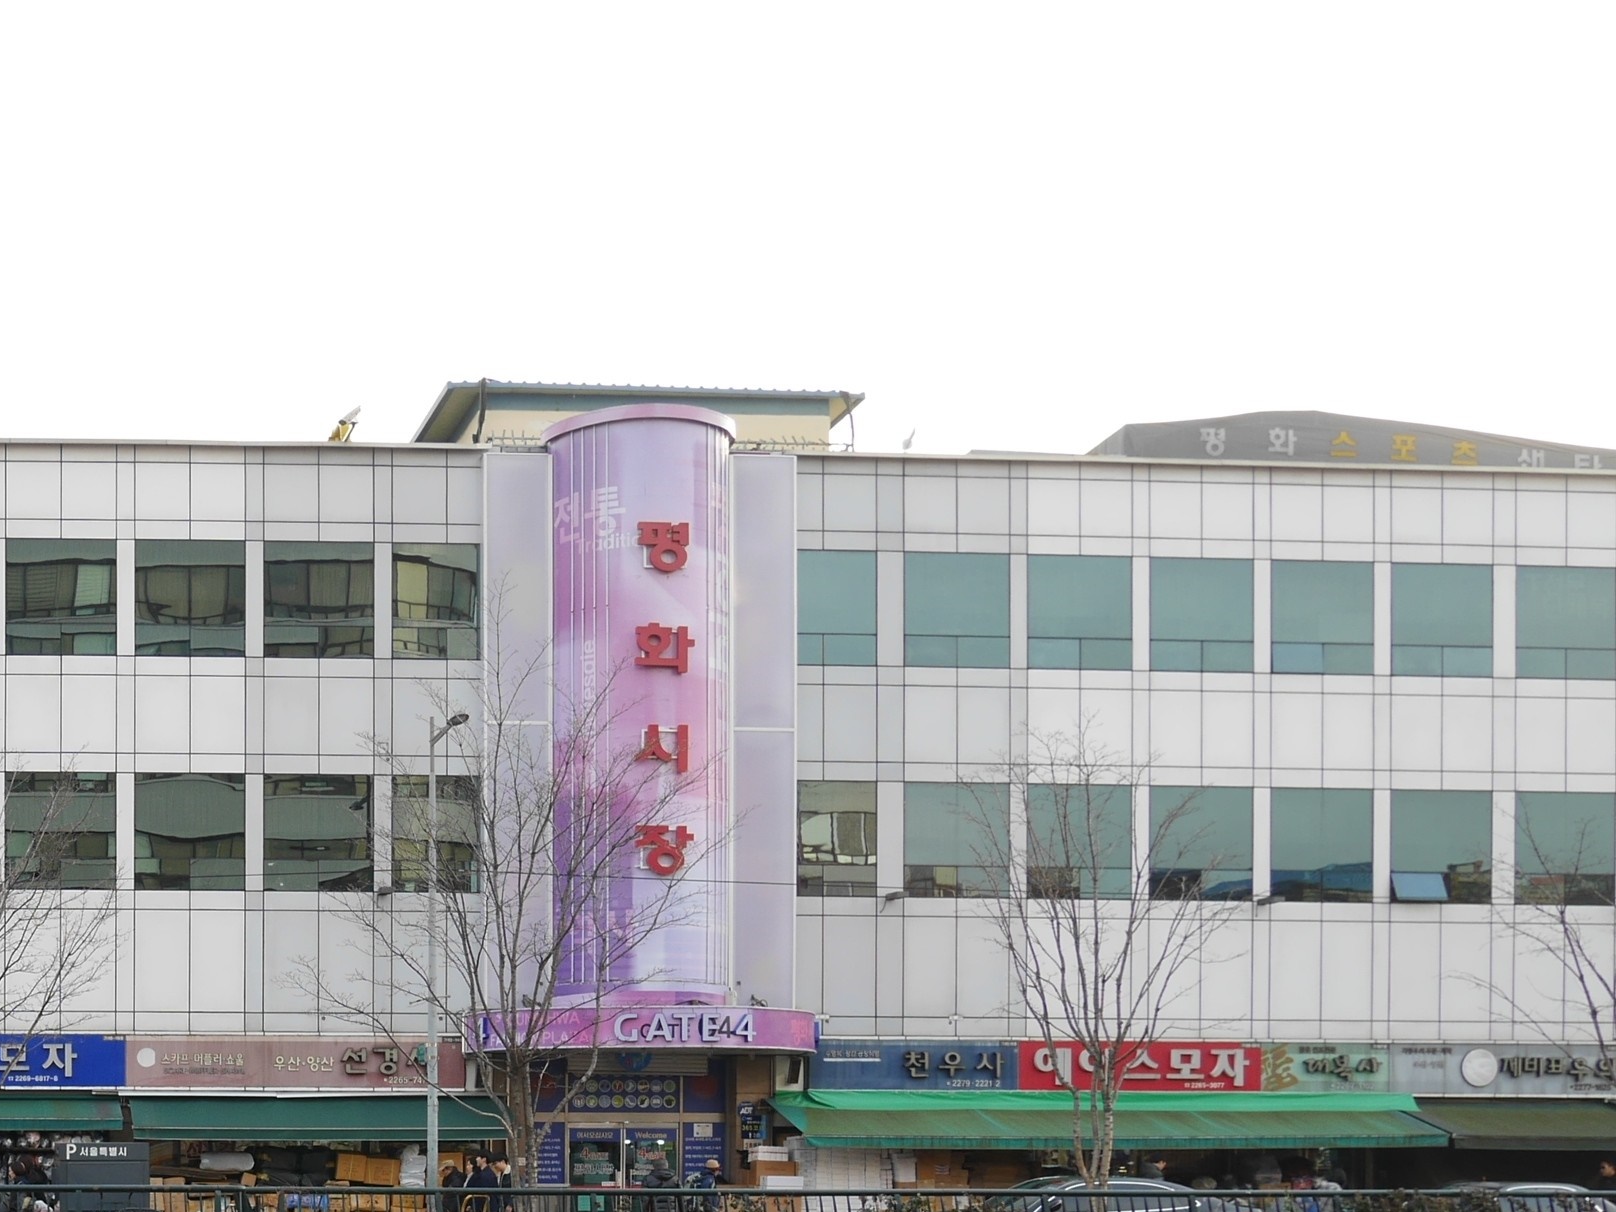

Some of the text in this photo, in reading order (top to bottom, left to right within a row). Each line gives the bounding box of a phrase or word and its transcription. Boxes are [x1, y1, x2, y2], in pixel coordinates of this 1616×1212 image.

[634, 521, 696, 877] 평화시장
[614, 1013, 721, 1042] GATE
[735, 1013, 757, 1042] 4
[904, 1051, 1004, 1078] 천우사
[634, 1131, 668, 1140] Welcome
[79, 1146, 128, 1157] 서울특별시
